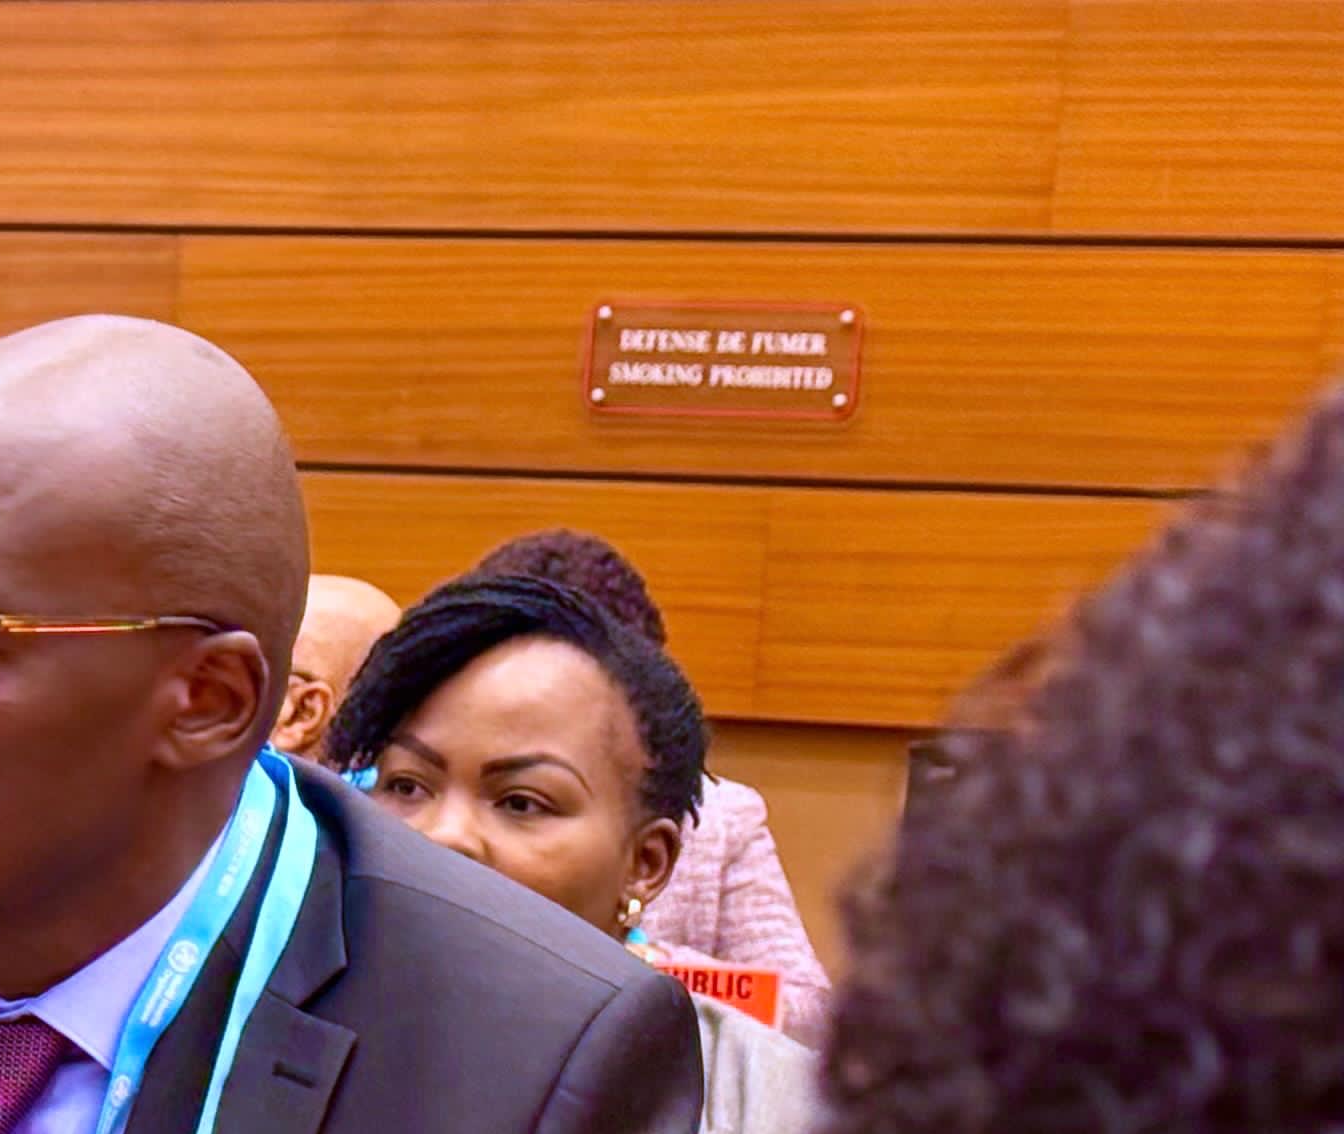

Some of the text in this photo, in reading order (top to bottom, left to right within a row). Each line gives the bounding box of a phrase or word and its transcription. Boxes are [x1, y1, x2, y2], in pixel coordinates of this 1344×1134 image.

[716, 331, 745, 354] DE
[751, 333, 827, 356] FUMER
[608, 361, 834, 390] SMOKING PROHIBITED
[664, 967, 753, 1000] BLIC
